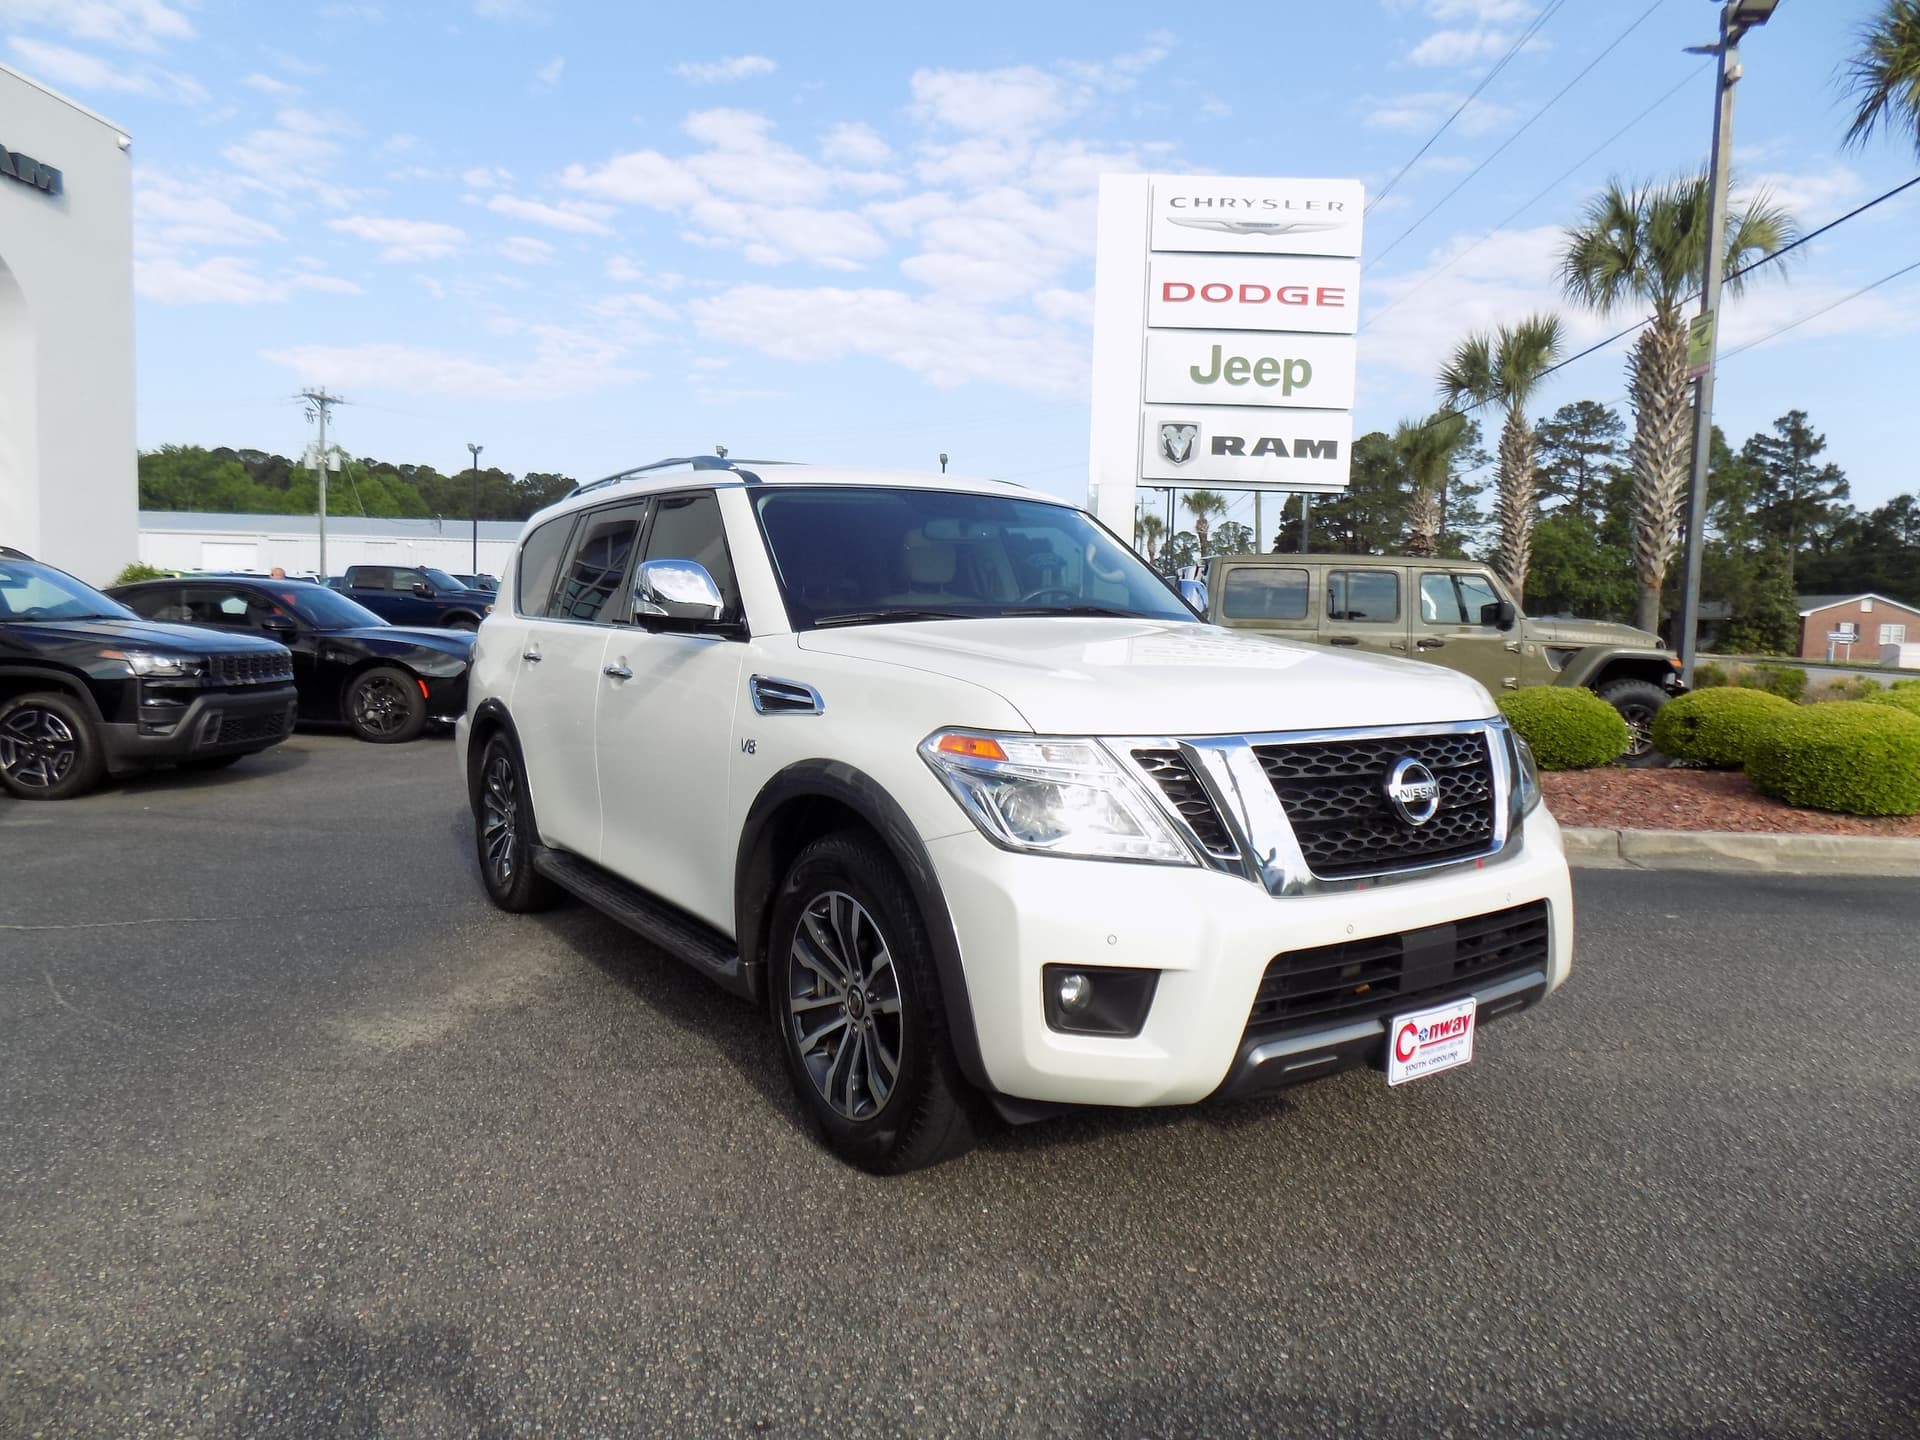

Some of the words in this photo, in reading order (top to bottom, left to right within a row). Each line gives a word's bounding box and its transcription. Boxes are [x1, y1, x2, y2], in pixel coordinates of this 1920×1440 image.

[1169, 196, 1345, 213] CHRYSLER
[1162, 282, 1346, 308] DODGE
[1190, 344, 1313, 397] Jeep
[1211, 435, 1339, 460] RAM
[741, 737, 757, 755] V8
[1395, 1013, 1472, 1063] Conway
